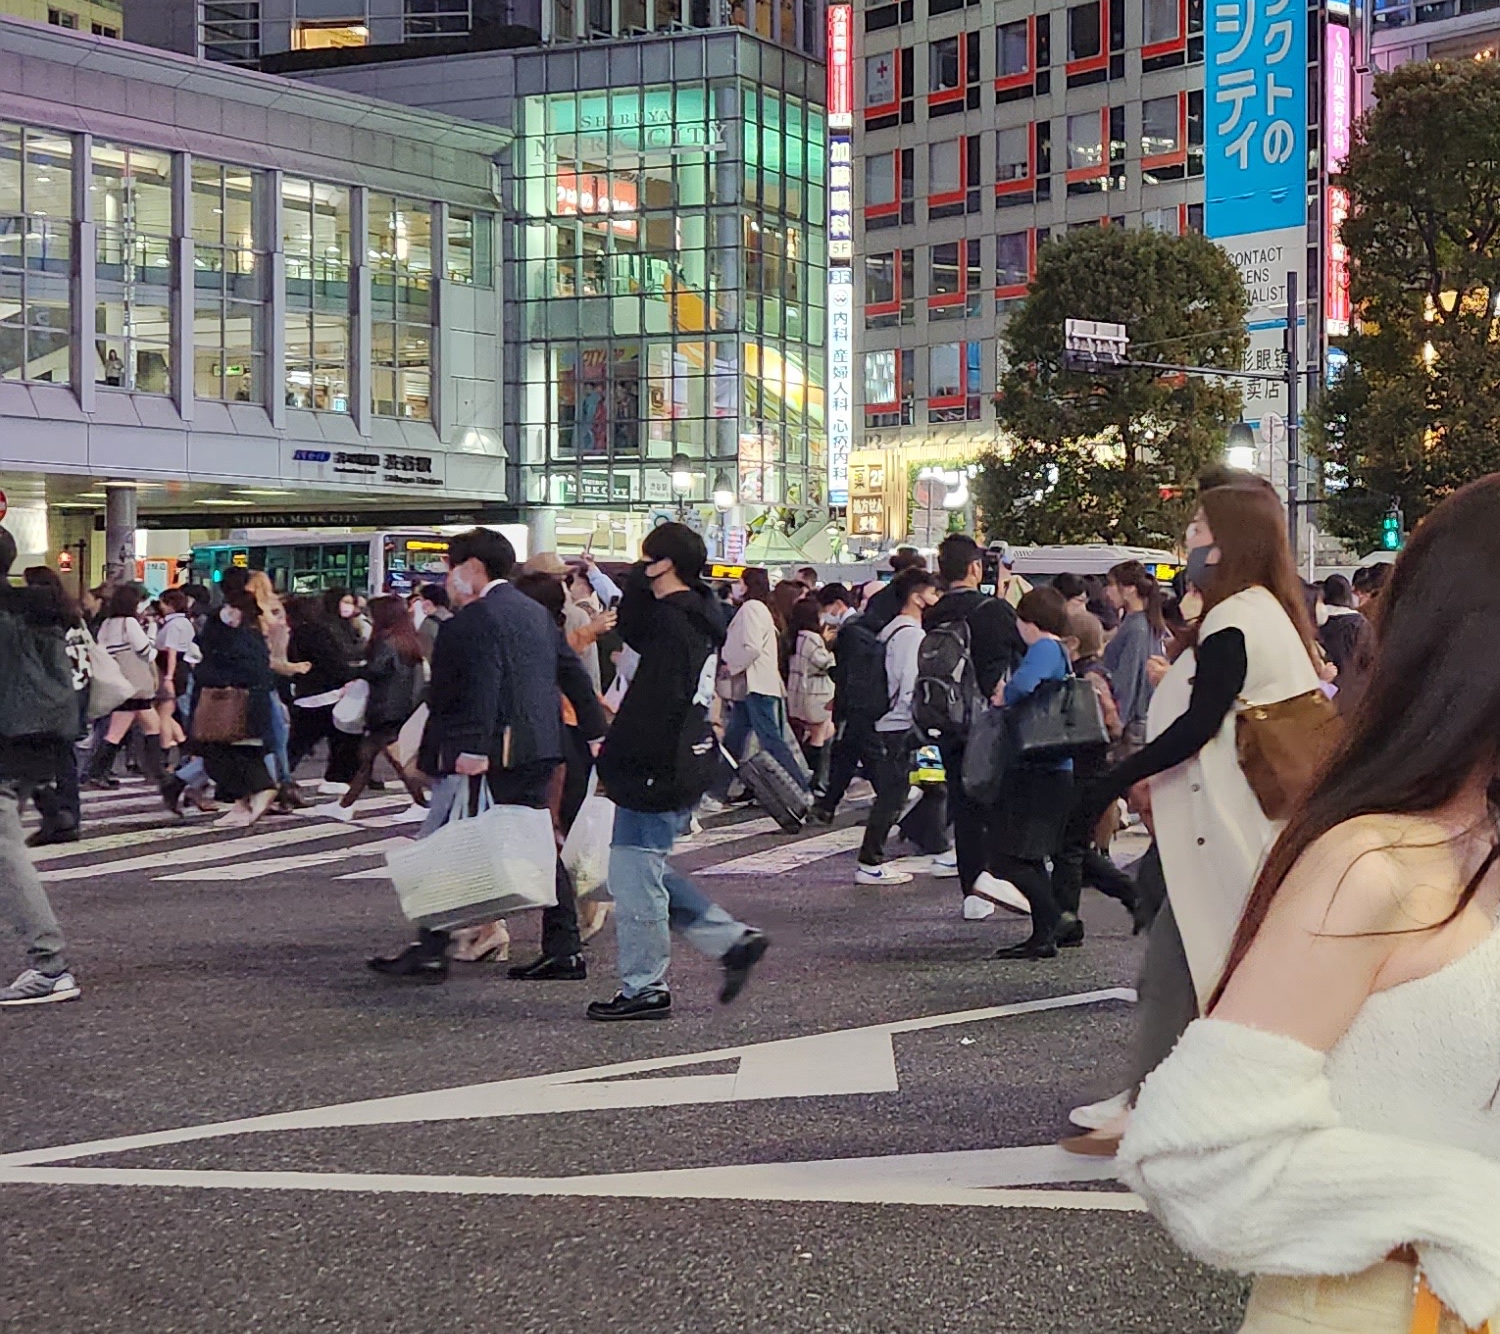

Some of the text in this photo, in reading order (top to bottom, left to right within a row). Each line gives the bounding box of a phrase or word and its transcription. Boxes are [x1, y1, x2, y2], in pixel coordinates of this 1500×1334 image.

[581, 110, 672, 128] SHIBUYA
[646, 123, 728, 149] CITY
[832, 244, 848, 254] 5F
[1228, 246, 1284, 267] CONTACT
[1247, 285, 1286, 307] IALIST
[833, 312, 848, 342] 内科
[833, 348, 848, 412] 産婦人科
[602, 486, 629, 497] CTY
